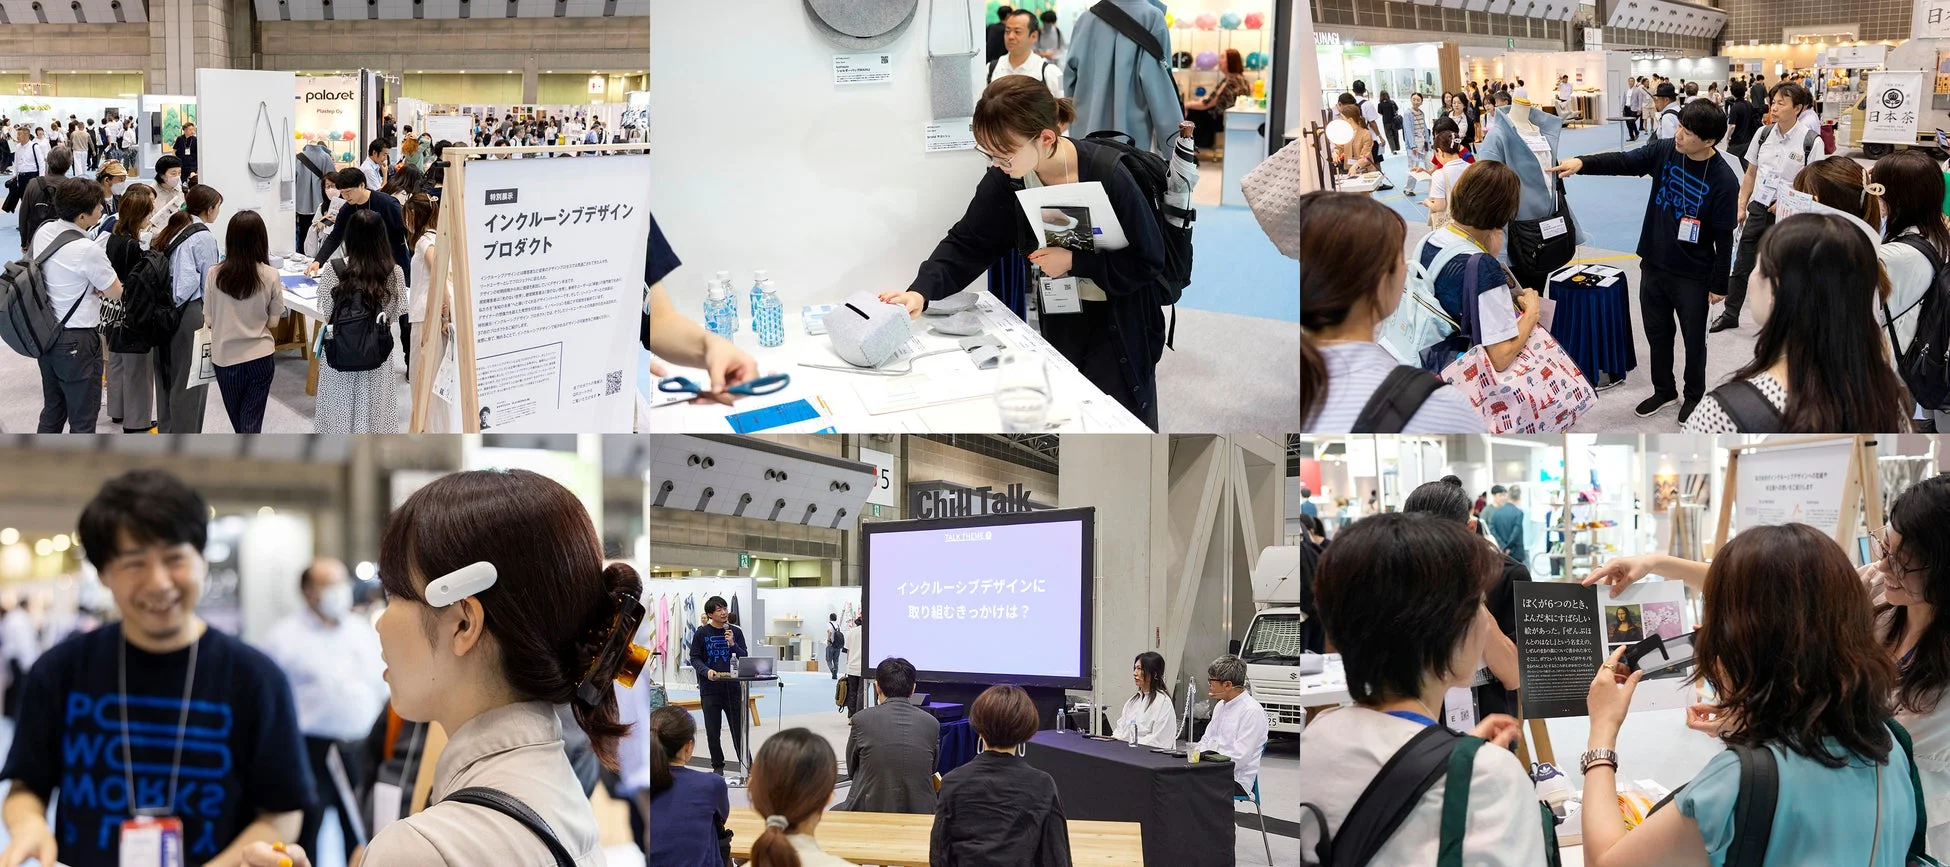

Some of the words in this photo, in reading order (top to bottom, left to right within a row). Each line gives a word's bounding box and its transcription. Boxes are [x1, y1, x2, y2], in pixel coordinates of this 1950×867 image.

[306, 89, 354, 103] palaset
[1869, 111, 1914, 124] 日本茶
[490, 191, 514, 201] 特別展示
[484, 203, 634, 233] インクルーシブデザイン
[483, 236, 553, 260] プロダクト
[917, 488, 972, 520] Chill
[976, 483, 1033, 516] Talk
[897, 578, 1046, 595] インクルーシブデザインに
[1523, 598, 1589, 610] ぼくが6つのとき、
[908, 604, 1029, 620] 取り組むきっかけは？
[1523, 613, 1591, 623] よんだ本にすばらしい
